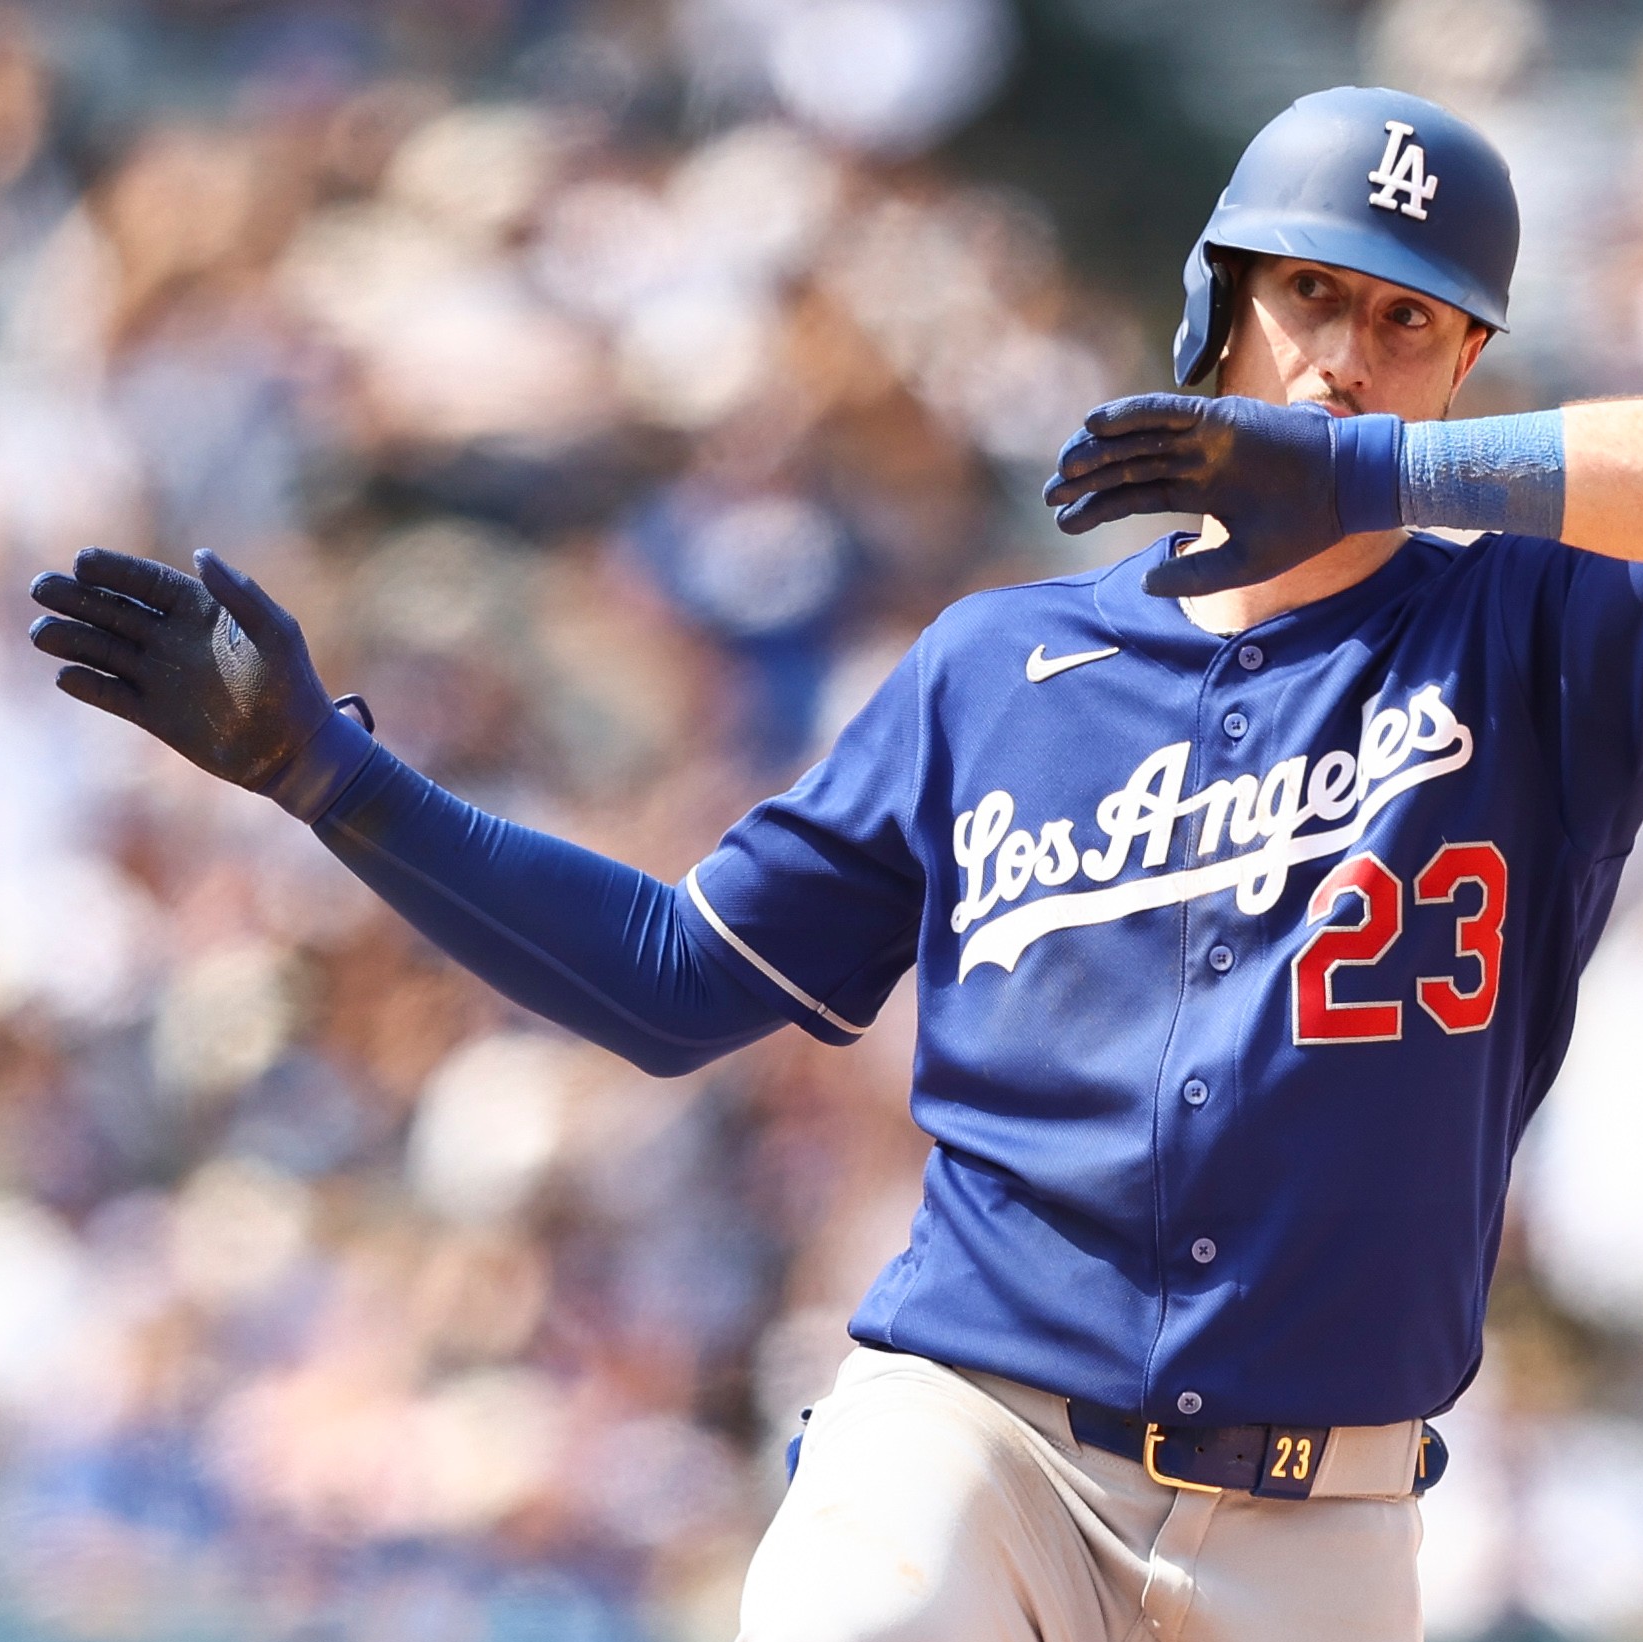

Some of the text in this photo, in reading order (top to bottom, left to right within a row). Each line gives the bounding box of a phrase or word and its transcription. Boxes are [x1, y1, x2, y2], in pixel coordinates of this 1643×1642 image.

[1368, 120, 1439, 221] LA
[950, 684, 1464, 934] Los Angeles
[1291, 840, 1508, 1045] 23
[1270, 1436, 1312, 1480] 23
